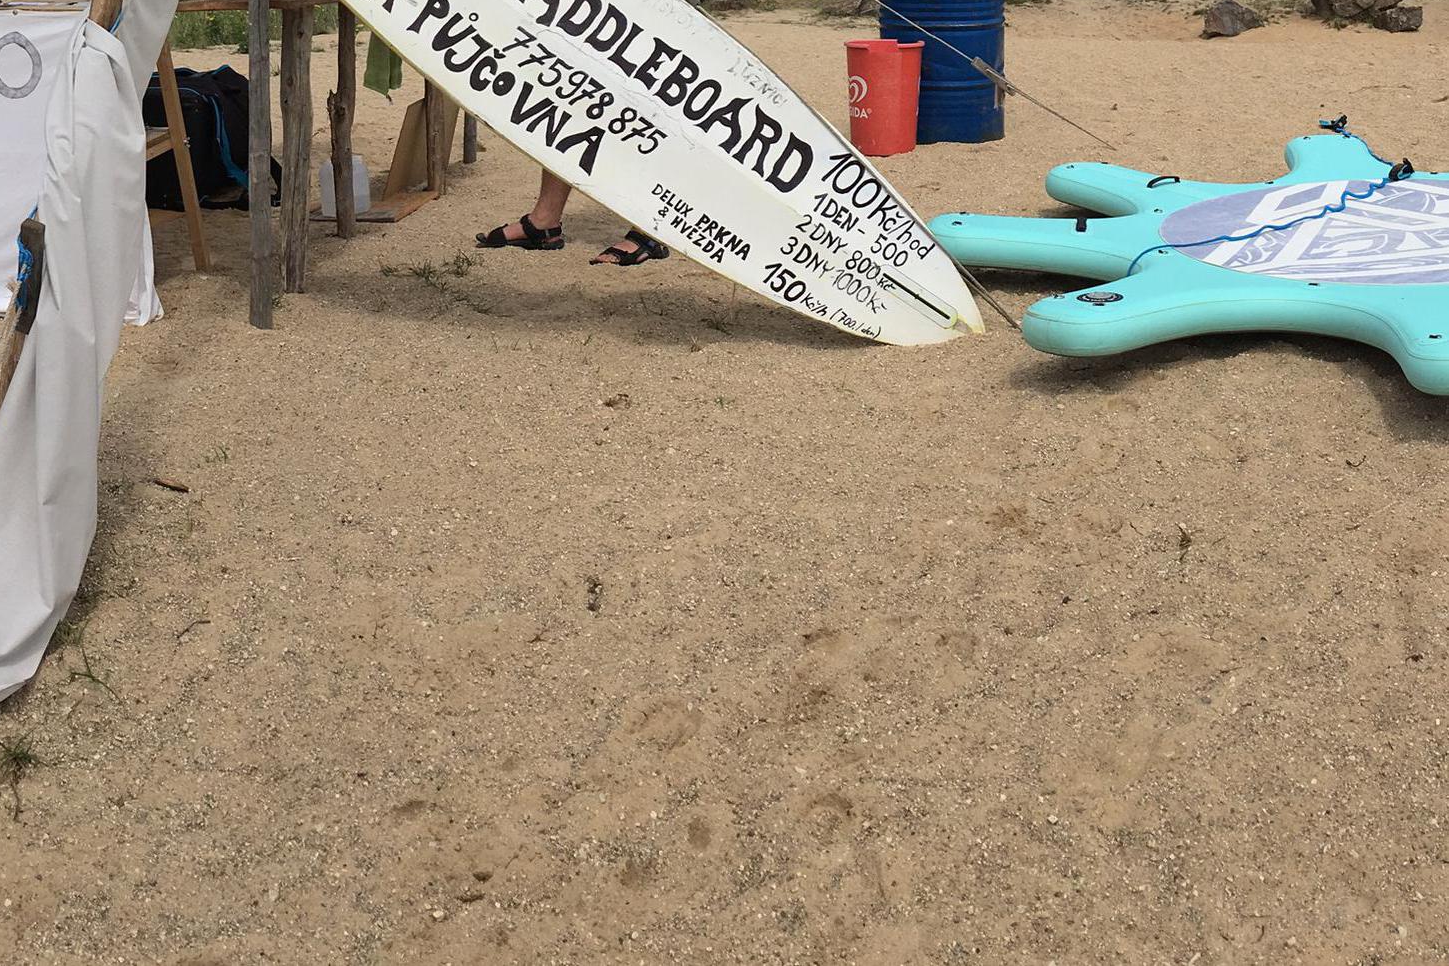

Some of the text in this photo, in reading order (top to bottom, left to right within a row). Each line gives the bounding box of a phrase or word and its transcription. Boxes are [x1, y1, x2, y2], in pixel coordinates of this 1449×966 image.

[651, 183, 752, 262] DELUX PRKNA
[870, 233, 909, 268] 500
